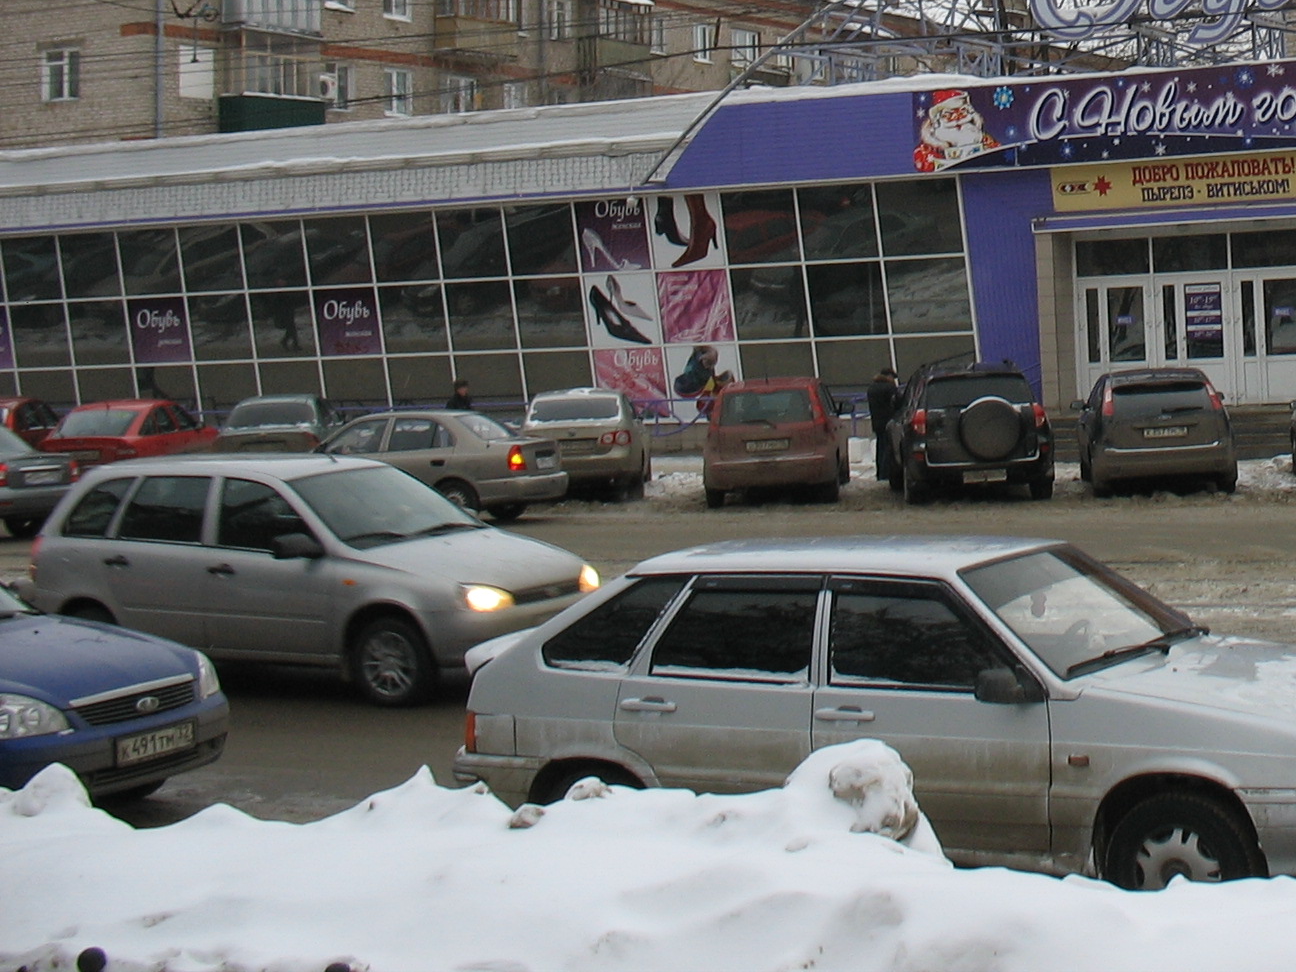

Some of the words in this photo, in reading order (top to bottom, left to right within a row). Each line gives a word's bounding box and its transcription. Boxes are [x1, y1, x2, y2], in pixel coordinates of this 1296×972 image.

[1030, 88, 1069, 140] С
[1074, 81, 1244, 134] Новым
[1131, 164, 1180, 186] ДОБРО
[1184, 156, 1296, 181] ПОЖАЛОВАТЬ!
[1142, 185, 1194, 202] ПЫРЕЛЭ
[1206, 178, 1291, 199] ВИТИСЬКОМ!
[137, 308, 181, 334] Обувь
[323, 299, 371, 325] Обувь
[614, 348, 659, 372] Обувь
